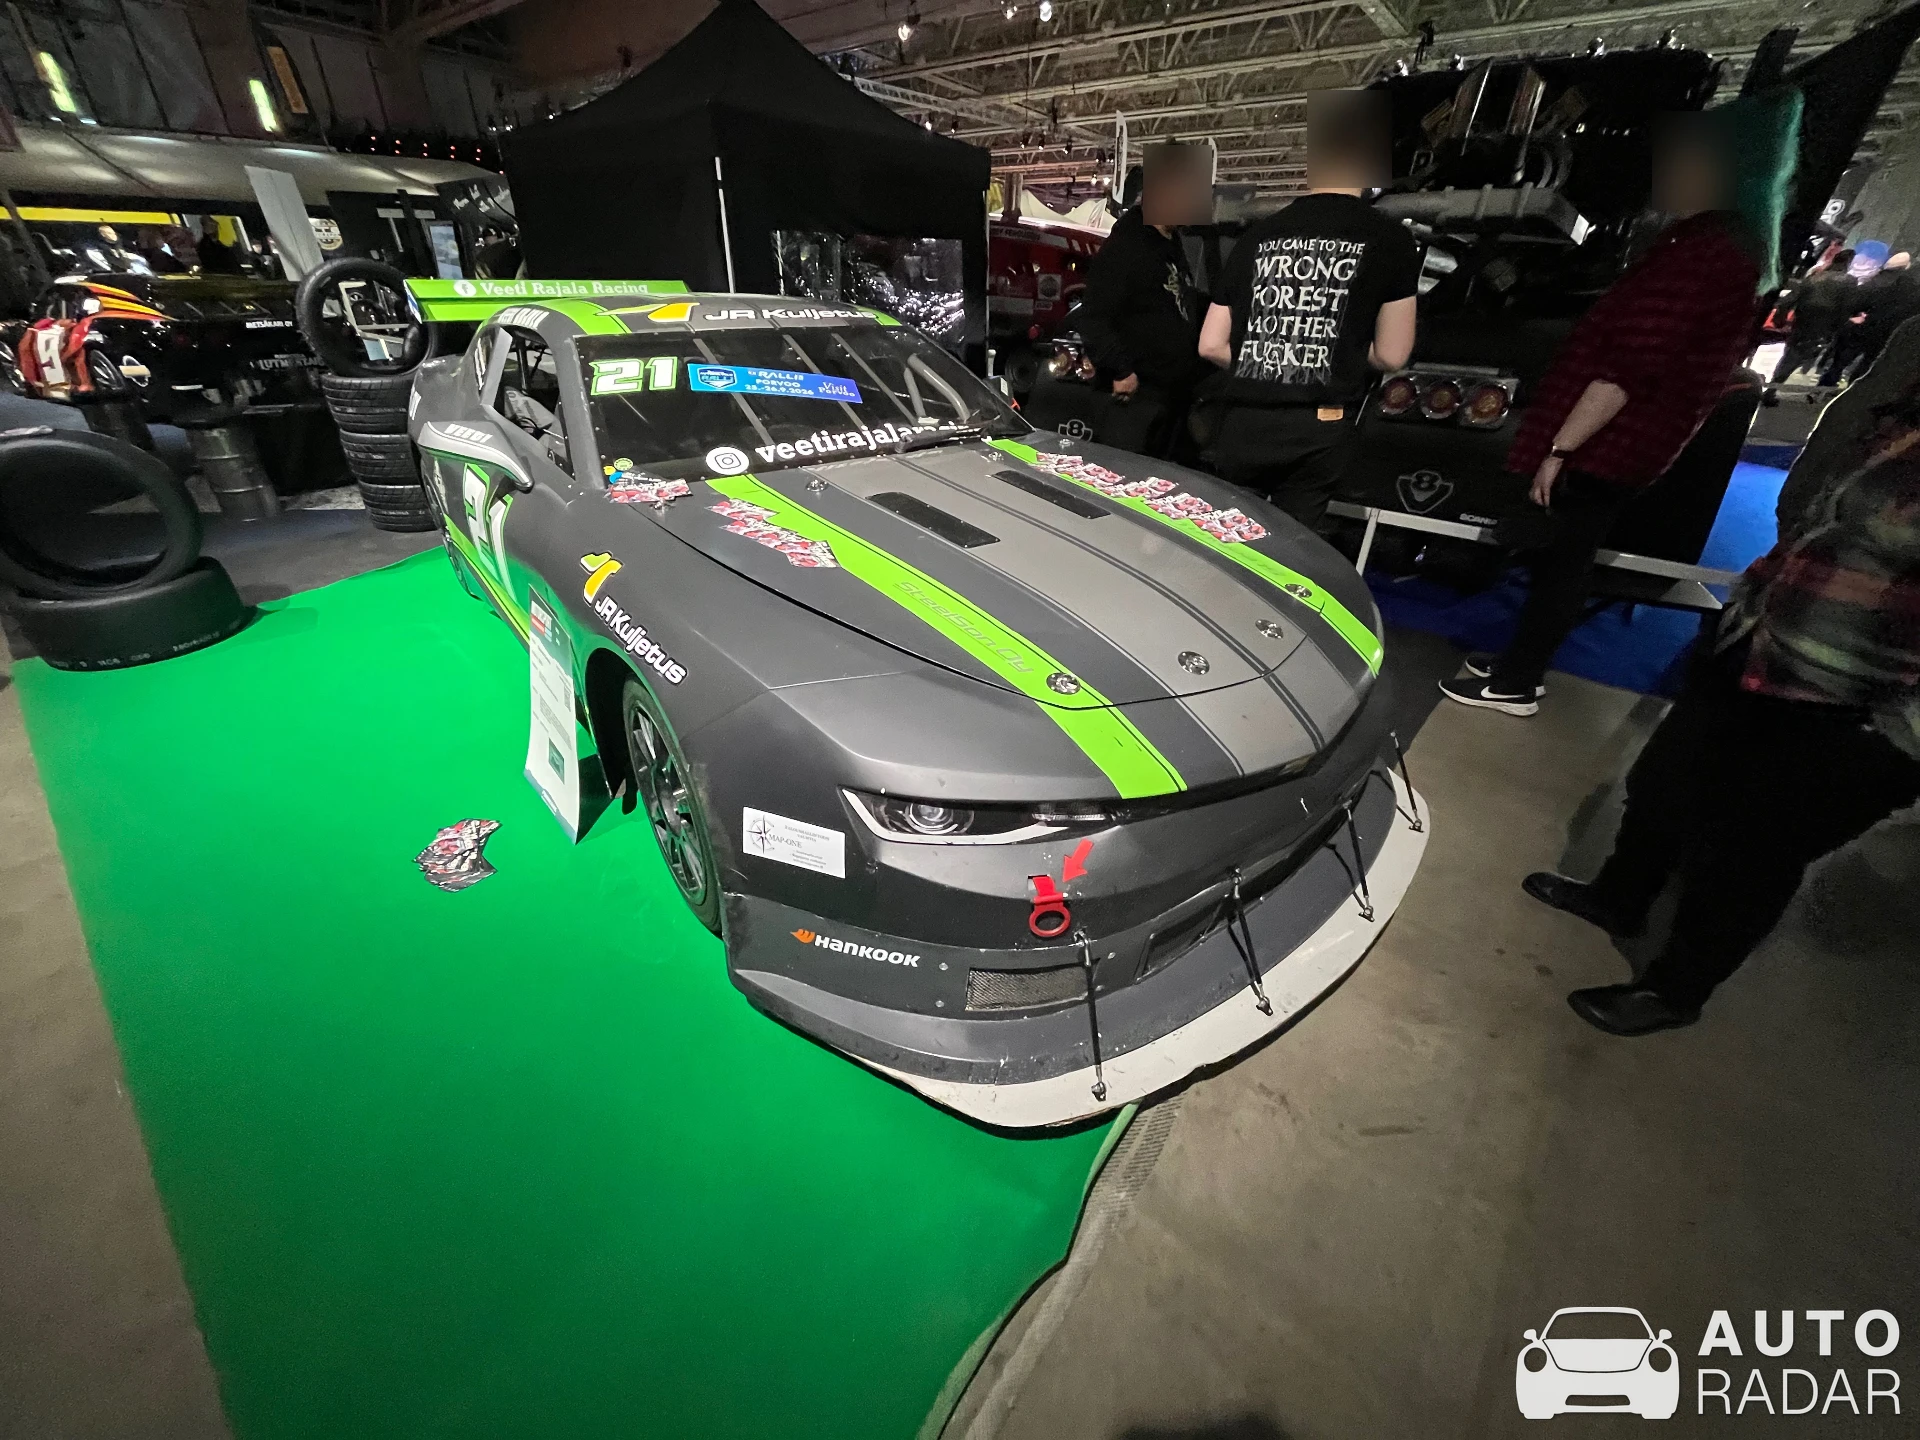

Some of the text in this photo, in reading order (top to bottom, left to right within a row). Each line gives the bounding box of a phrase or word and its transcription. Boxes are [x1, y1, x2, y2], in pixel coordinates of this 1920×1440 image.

[1258, 239, 1365, 255] YOU CAME TO THE
[1255, 255, 1357, 281] WRONG
[480, 281, 649, 298] Veeti Rajala Racing
[1252, 284, 1349, 312] FOREST
[762, 307, 878, 321] Kuljetus
[1247, 315, 1338, 339] MOTHER
[588, 356, 679, 396] 21
[756, 378, 801, 389] PORVOO
[818, 386, 856, 398] Porvoo
[823, 381, 847, 391] Visit
[594, 596, 618, 622] JR
[609, 608, 688, 685] Kuljetus
[769, 833, 803, 849] MAP-ONE
